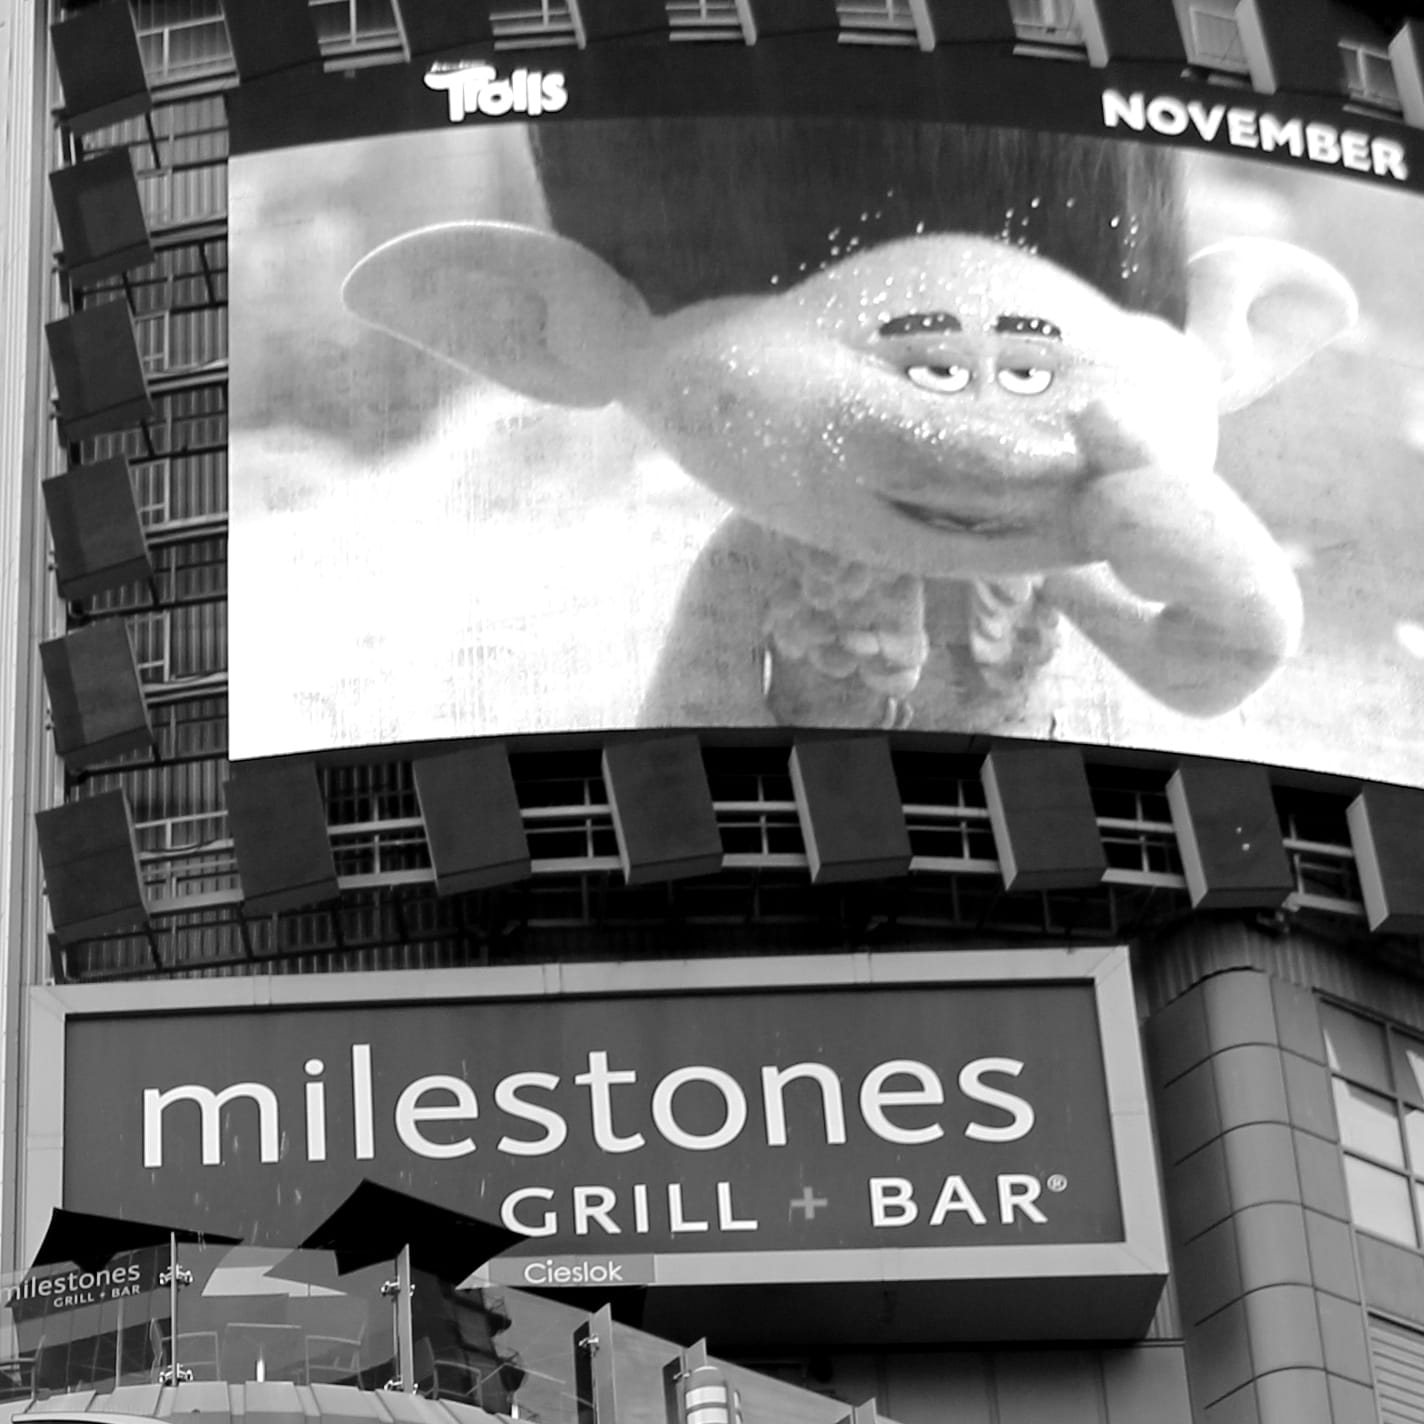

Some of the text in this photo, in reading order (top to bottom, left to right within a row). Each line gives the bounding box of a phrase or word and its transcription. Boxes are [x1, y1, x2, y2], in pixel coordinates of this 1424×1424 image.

[424, 65, 568, 122] Trolls
[1101, 88, 1409, 181] NOVEMBER
[143, 1043, 1036, 1168] milestones
[500, 1182, 758, 1238] GRILL
[53, 1283, 141, 1308] GRILL BAR
[524, 1259, 623, 1284] Cieslok
